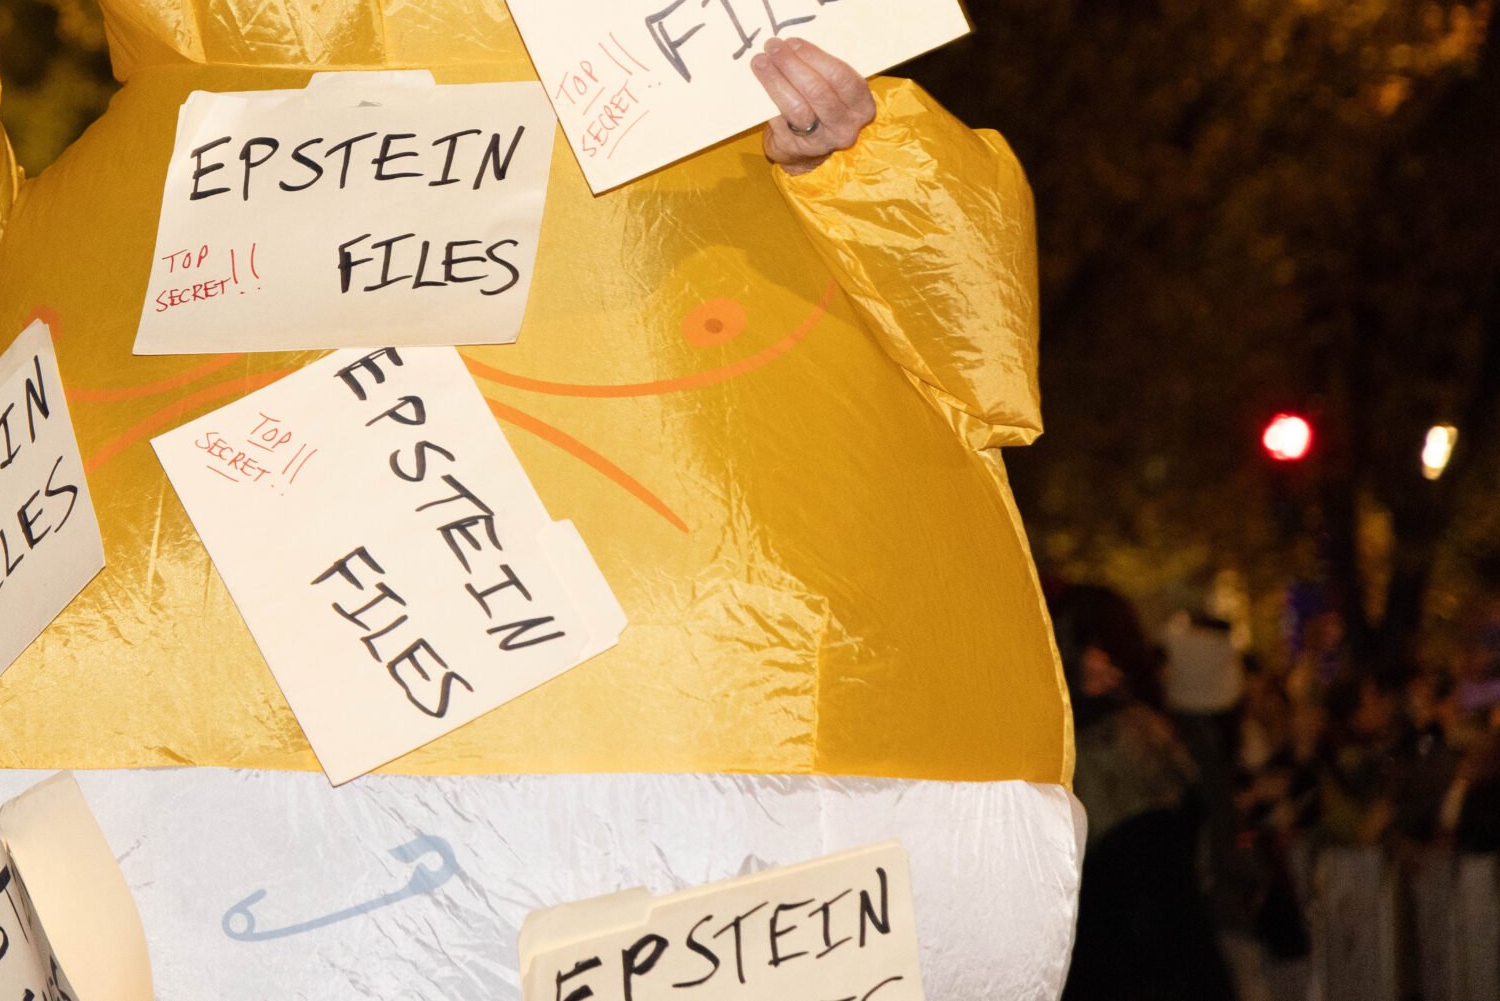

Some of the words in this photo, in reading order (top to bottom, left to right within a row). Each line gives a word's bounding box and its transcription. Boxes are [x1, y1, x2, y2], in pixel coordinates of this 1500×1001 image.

[555, 60, 599, 105] TOP
[189, 125, 526, 201] EPSTEIN
[161, 244, 209, 274] TOP
[337, 232, 520, 296] FILES
[250, 411, 292, 450] TOP
[333, 346, 566, 652] EPSTEIN
[310, 545, 474, 718] FILES
[555, 866, 892, 1001] EPSTEIN
